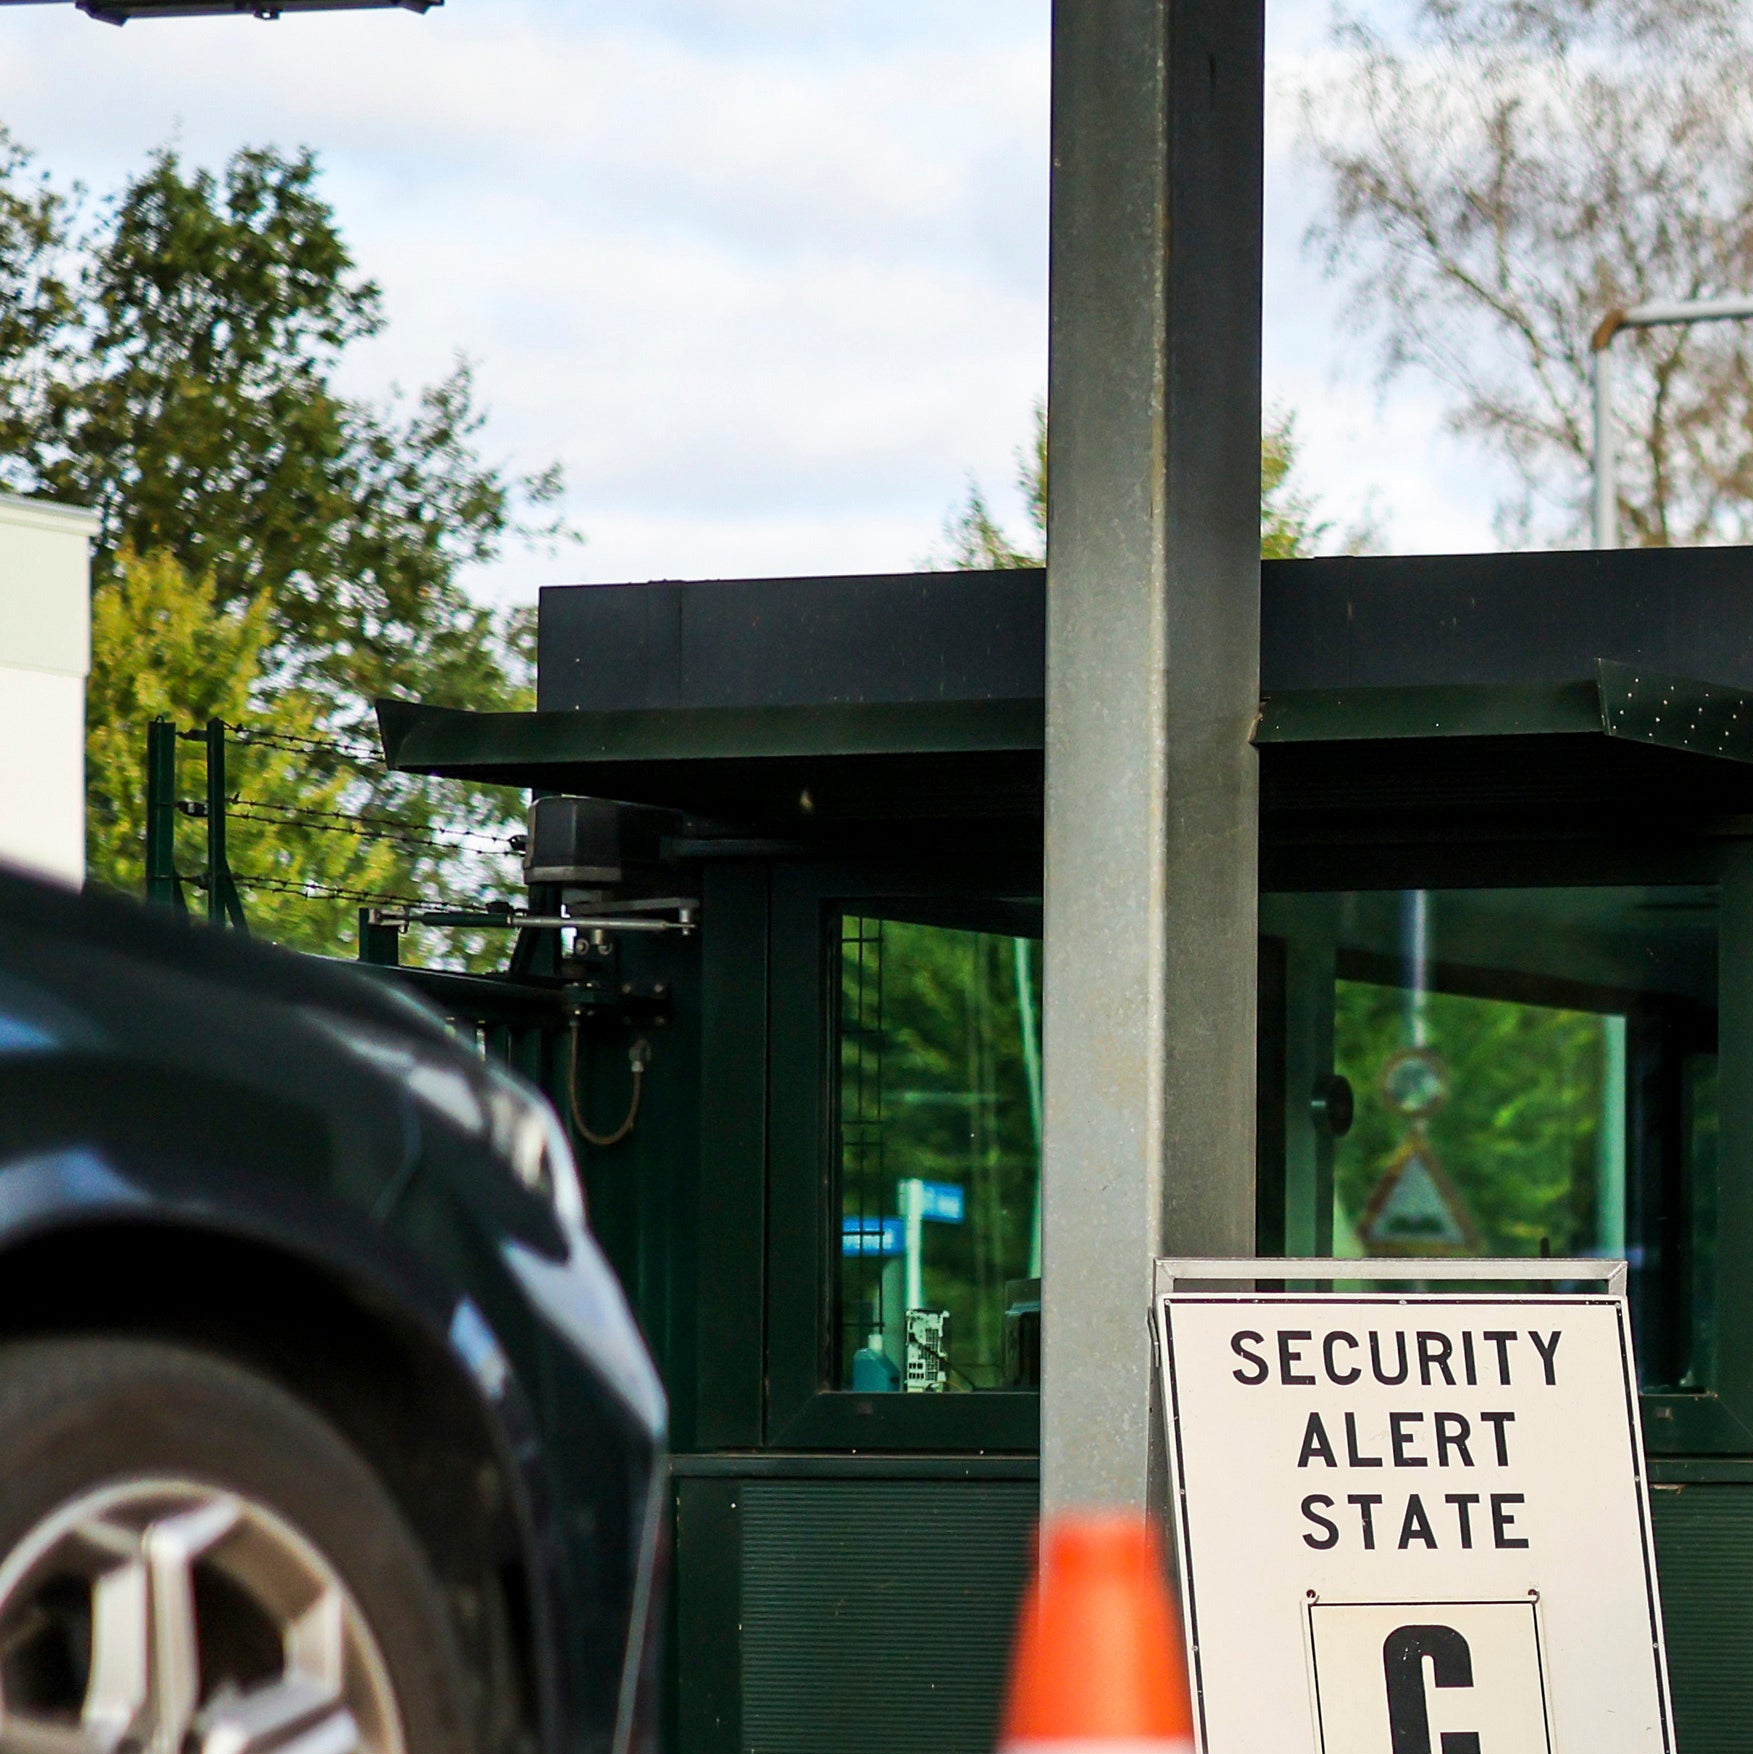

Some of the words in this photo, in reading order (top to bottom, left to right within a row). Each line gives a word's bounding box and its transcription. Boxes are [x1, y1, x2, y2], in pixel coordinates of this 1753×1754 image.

[1230, 1330, 1562, 1386] SECURITY
[1297, 1411, 1516, 1468] ALERT
[1300, 1493, 1529, 1550] STATE
